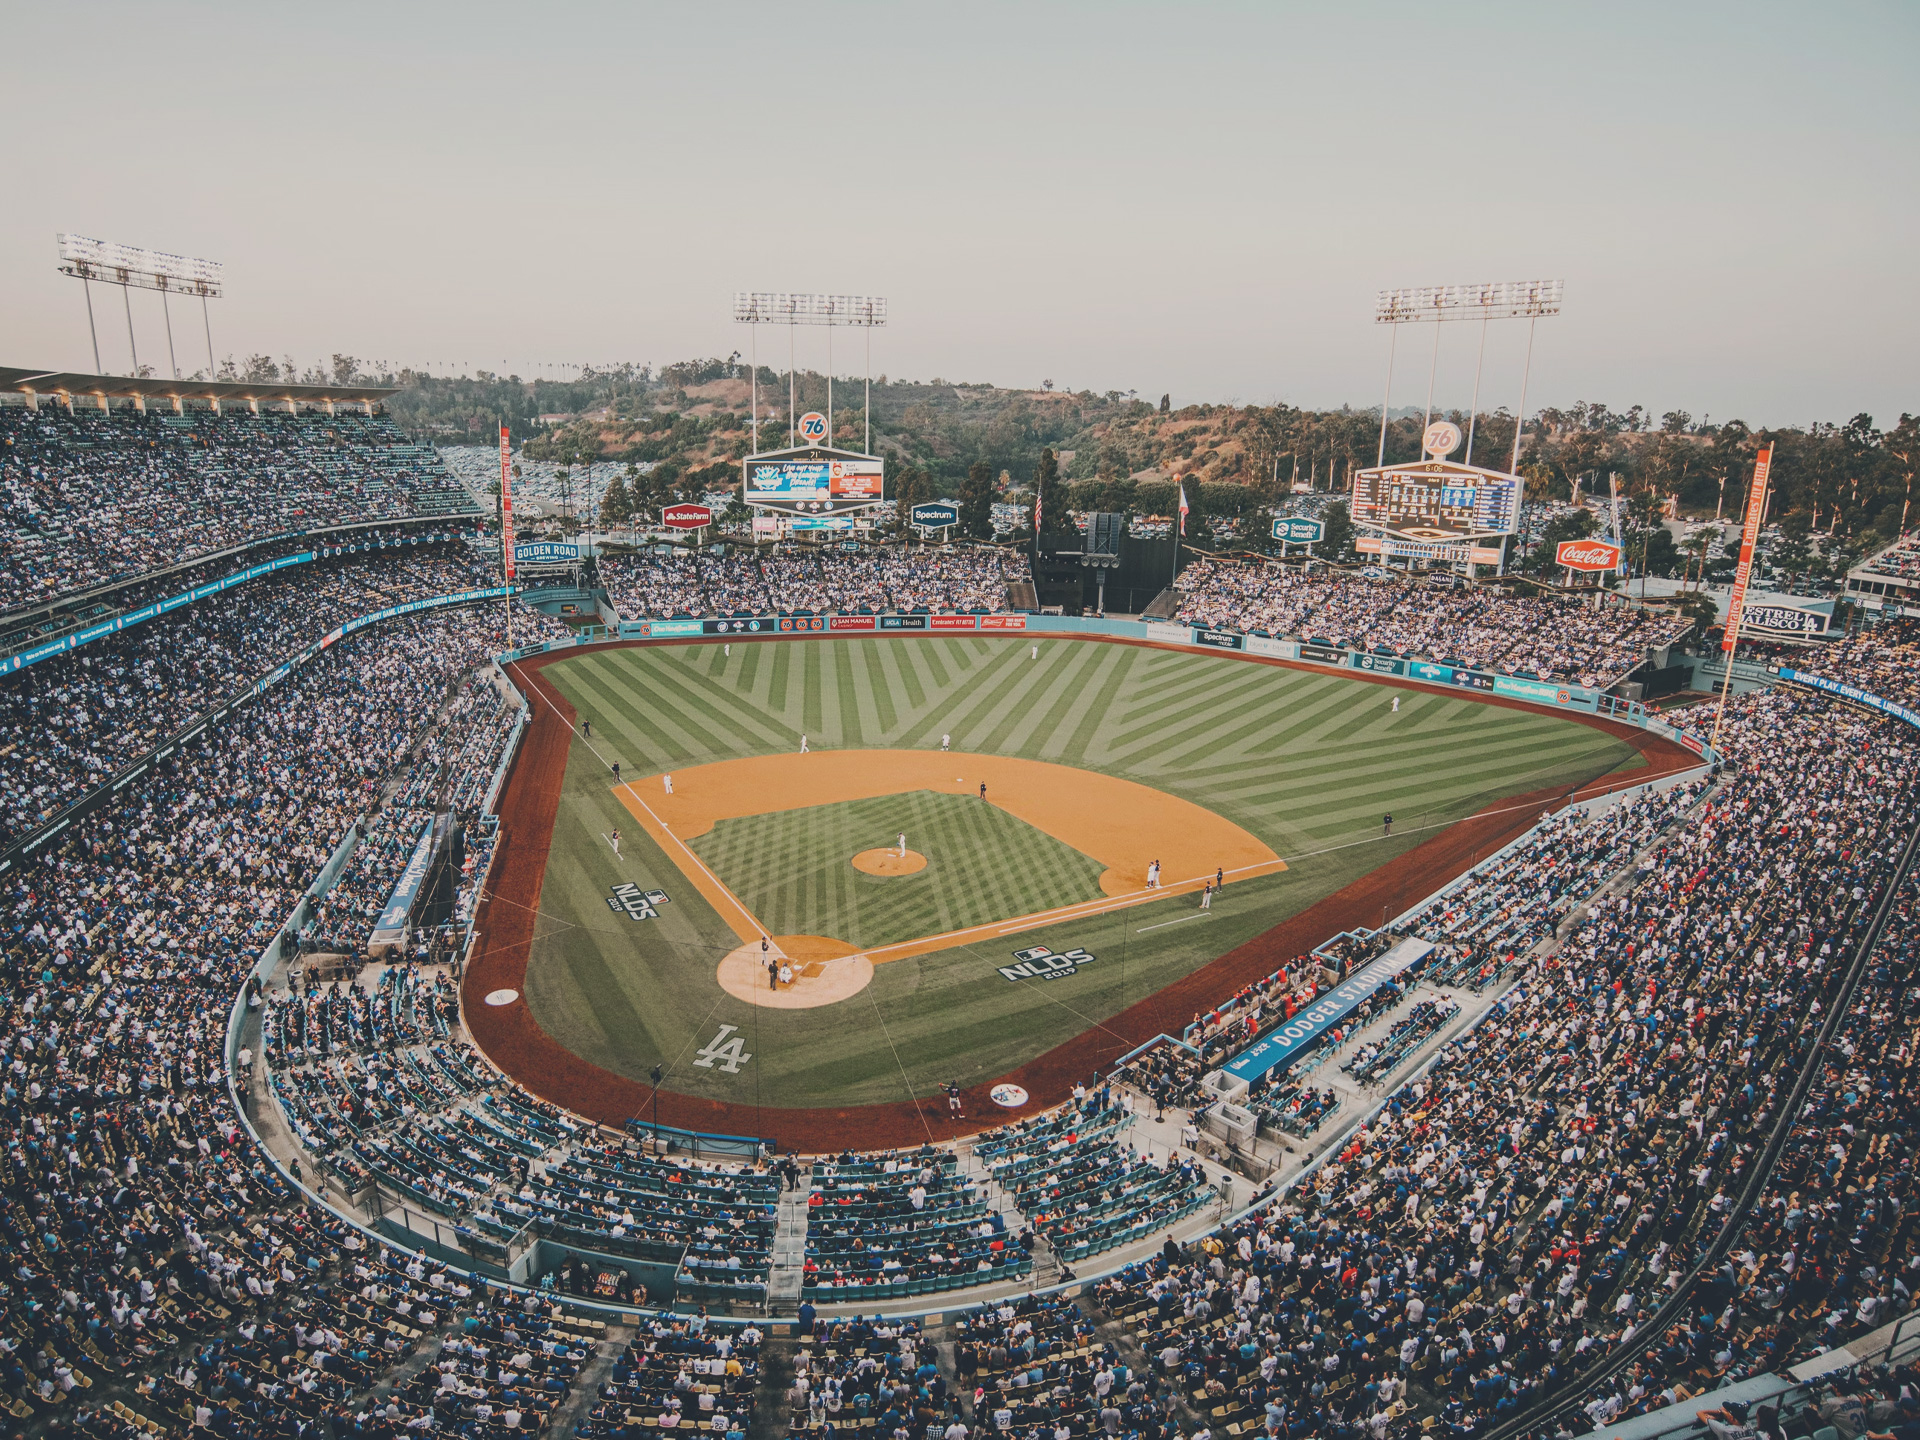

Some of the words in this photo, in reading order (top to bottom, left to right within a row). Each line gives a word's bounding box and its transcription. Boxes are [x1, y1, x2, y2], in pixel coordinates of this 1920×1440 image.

[805, 419, 824, 434] 76
[1429, 430, 1451, 447] 76
[1754, 462, 1767, 486] BETTER
[503, 465, 511, 499] Emirates
[1751, 485, 1762, 499] FLY
[915, 511, 952, 520] Spectrum
[1291, 523, 1317, 532] Security
[1742, 500, 1759, 547] Emirates
[1291, 531, 1313, 539] Benefit
[506, 538, 514, 571] Emirates
[517, 545, 550, 559] GOLDEN
[554, 545, 576, 557] ROAD
[1561, 546, 1614, 565] Coca-Cola
[1737, 561, 1748, 584] BETTER
[449, 594, 465, 602] RADIO
[1734, 584, 1744, 597] FLY
[1724, 599, 1741, 642] Emirates
[1204, 633, 1232, 642] Spectrum
[1374, 657, 1396, 668] Security
[1374, 663, 1392, 673] Benefit
[1793, 672, 1819, 685] EVERY
[1819, 679, 1839, 692] PLAY.
[1840, 685, 1863, 700] EVERY
[1883, 701, 1903, 716] LISTEN
[607, 898, 623, 911] 2019
[612, 883, 657, 920] NLDS
[999, 949, 1094, 980] NLDS
[1043, 967, 1076, 979] 2019
[1272, 1000, 1343, 1047] DODGER
[1337, 959, 1403, 1001] STADIUM
[692, 1024, 753, 1074] LA
[1000, 1417, 1008, 1425] 27
